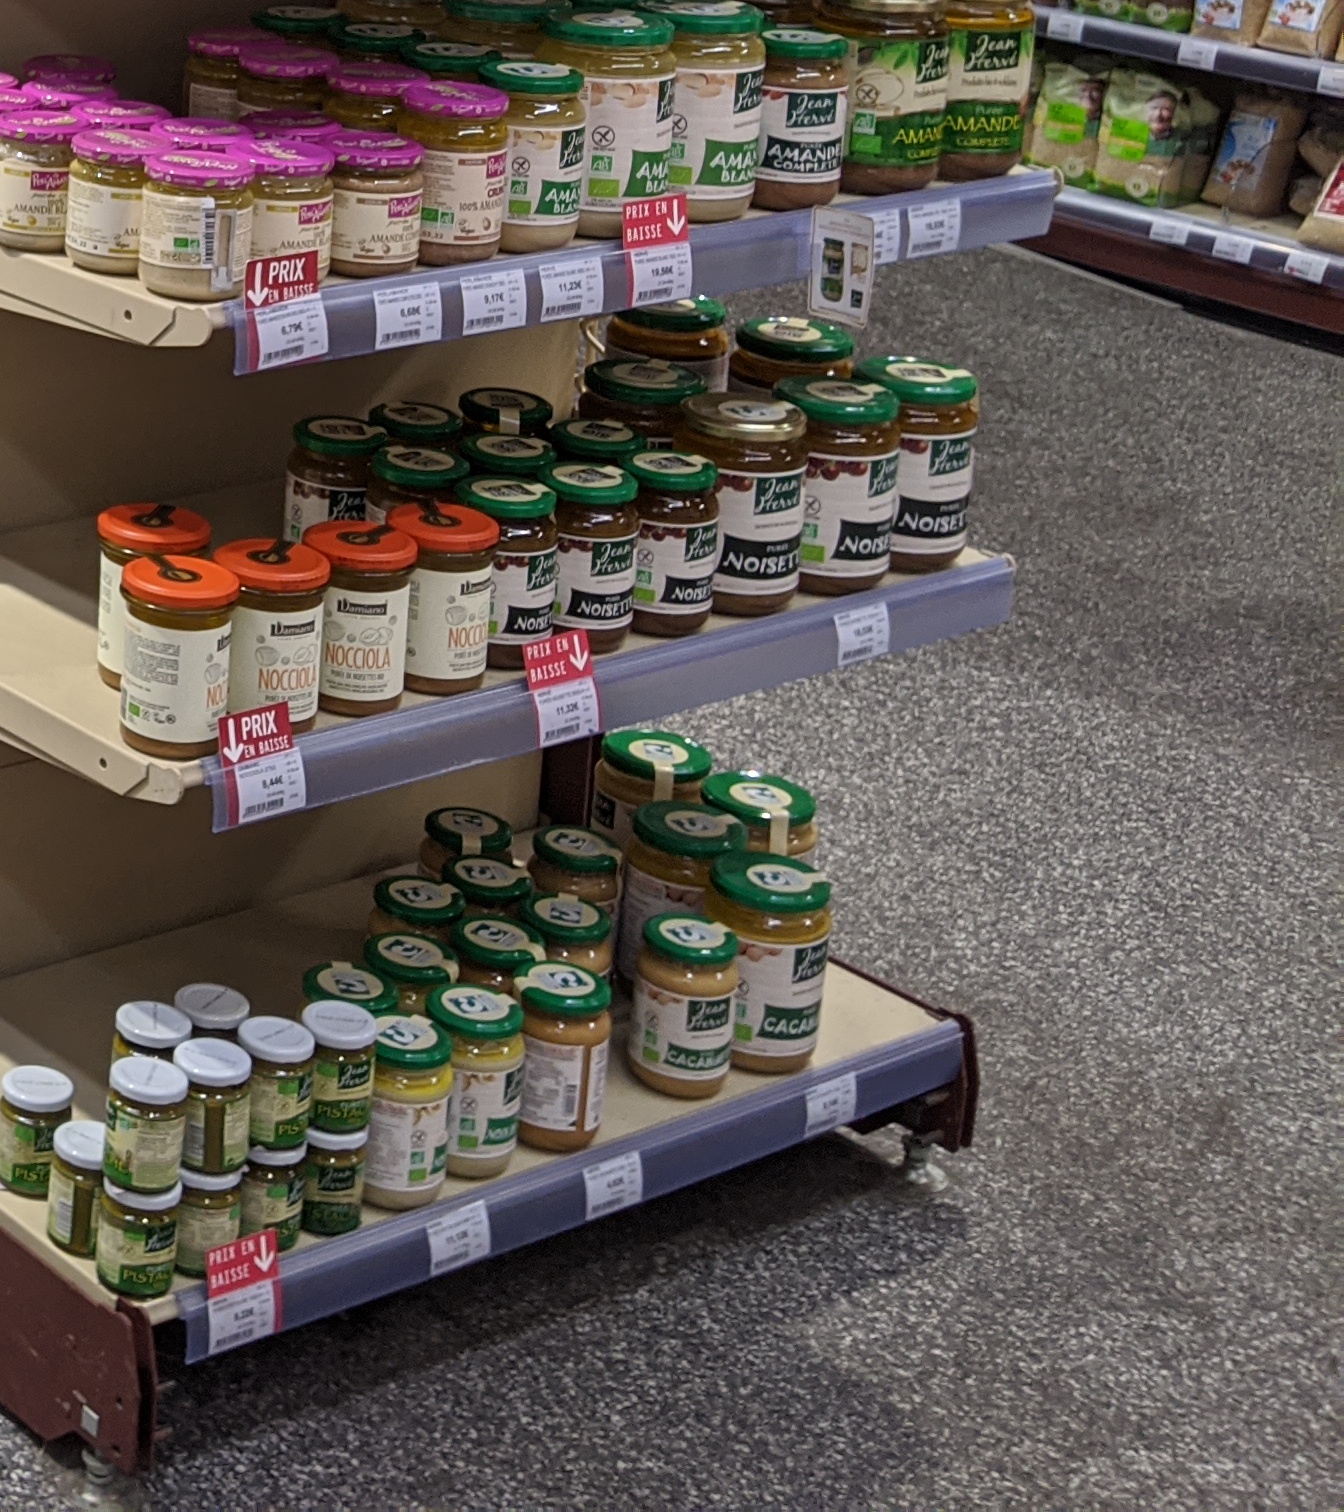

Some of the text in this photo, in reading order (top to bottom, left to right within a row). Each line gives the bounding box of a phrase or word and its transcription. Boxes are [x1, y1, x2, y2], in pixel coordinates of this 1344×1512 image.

[964, 51, 1019, 71] Hervé
[974, 37, 1017, 63] Jean
[794, 94, 835, 120] Jean
[786, 109, 836, 129] Hervé
[943, 114, 1022, 133] AMANDE
[767, 143, 842, 161] AMANDE
[625, 201, 668, 221] PRIX EN
[626, 223, 663, 243] BAISSE
[267, 258, 307, 286] PRIX
[267, 282, 315, 303] EN BAISSE
[341, 598, 387, 616] Damiano
[448, 625, 488, 649] NOCCIO
[525, 636, 571, 661] PRIX EN
[324, 643, 392, 670] NOCCIOLA
[258, 665, 317, 693] NOCCIOLA
[529, 661, 568, 684] BAISSE
[240, 711, 279, 740] PRIX
[244, 735, 290, 759] EN BAISSE
[208, 1241, 257, 1267] PRIX EN
[210, 1265, 252, 1288] BAISSE
